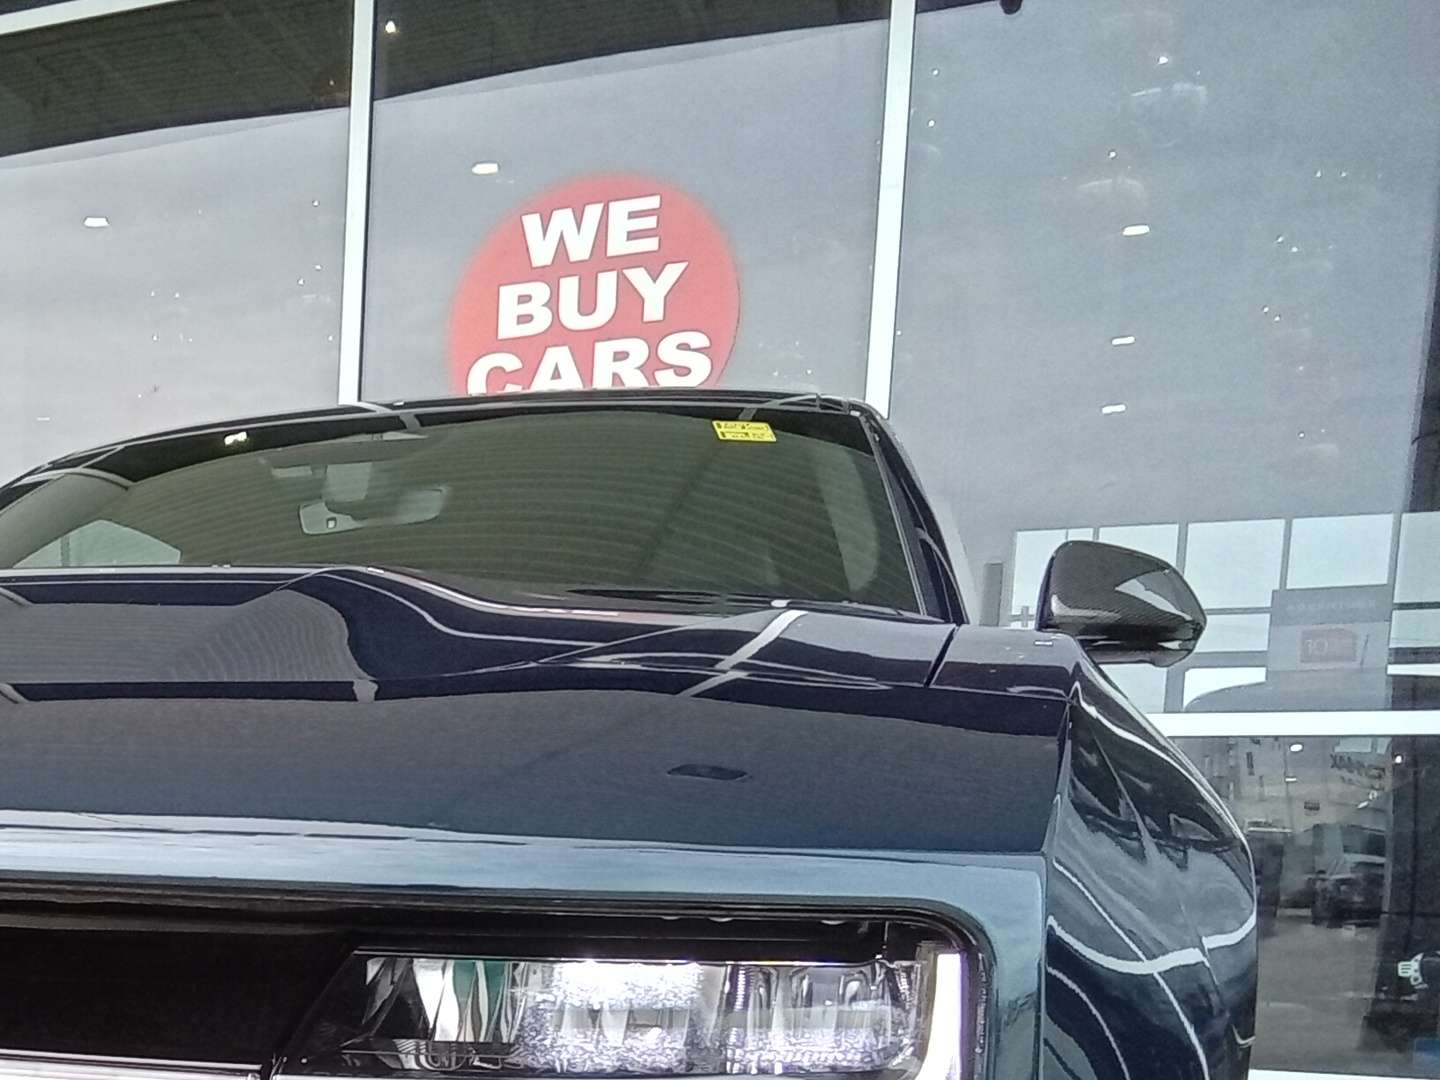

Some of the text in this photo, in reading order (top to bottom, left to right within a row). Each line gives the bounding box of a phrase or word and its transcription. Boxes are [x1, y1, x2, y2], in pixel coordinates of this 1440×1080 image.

[521, 194, 661, 268] WE
[497, 261, 689, 340] BUY
[466, 329, 712, 396] CARS
